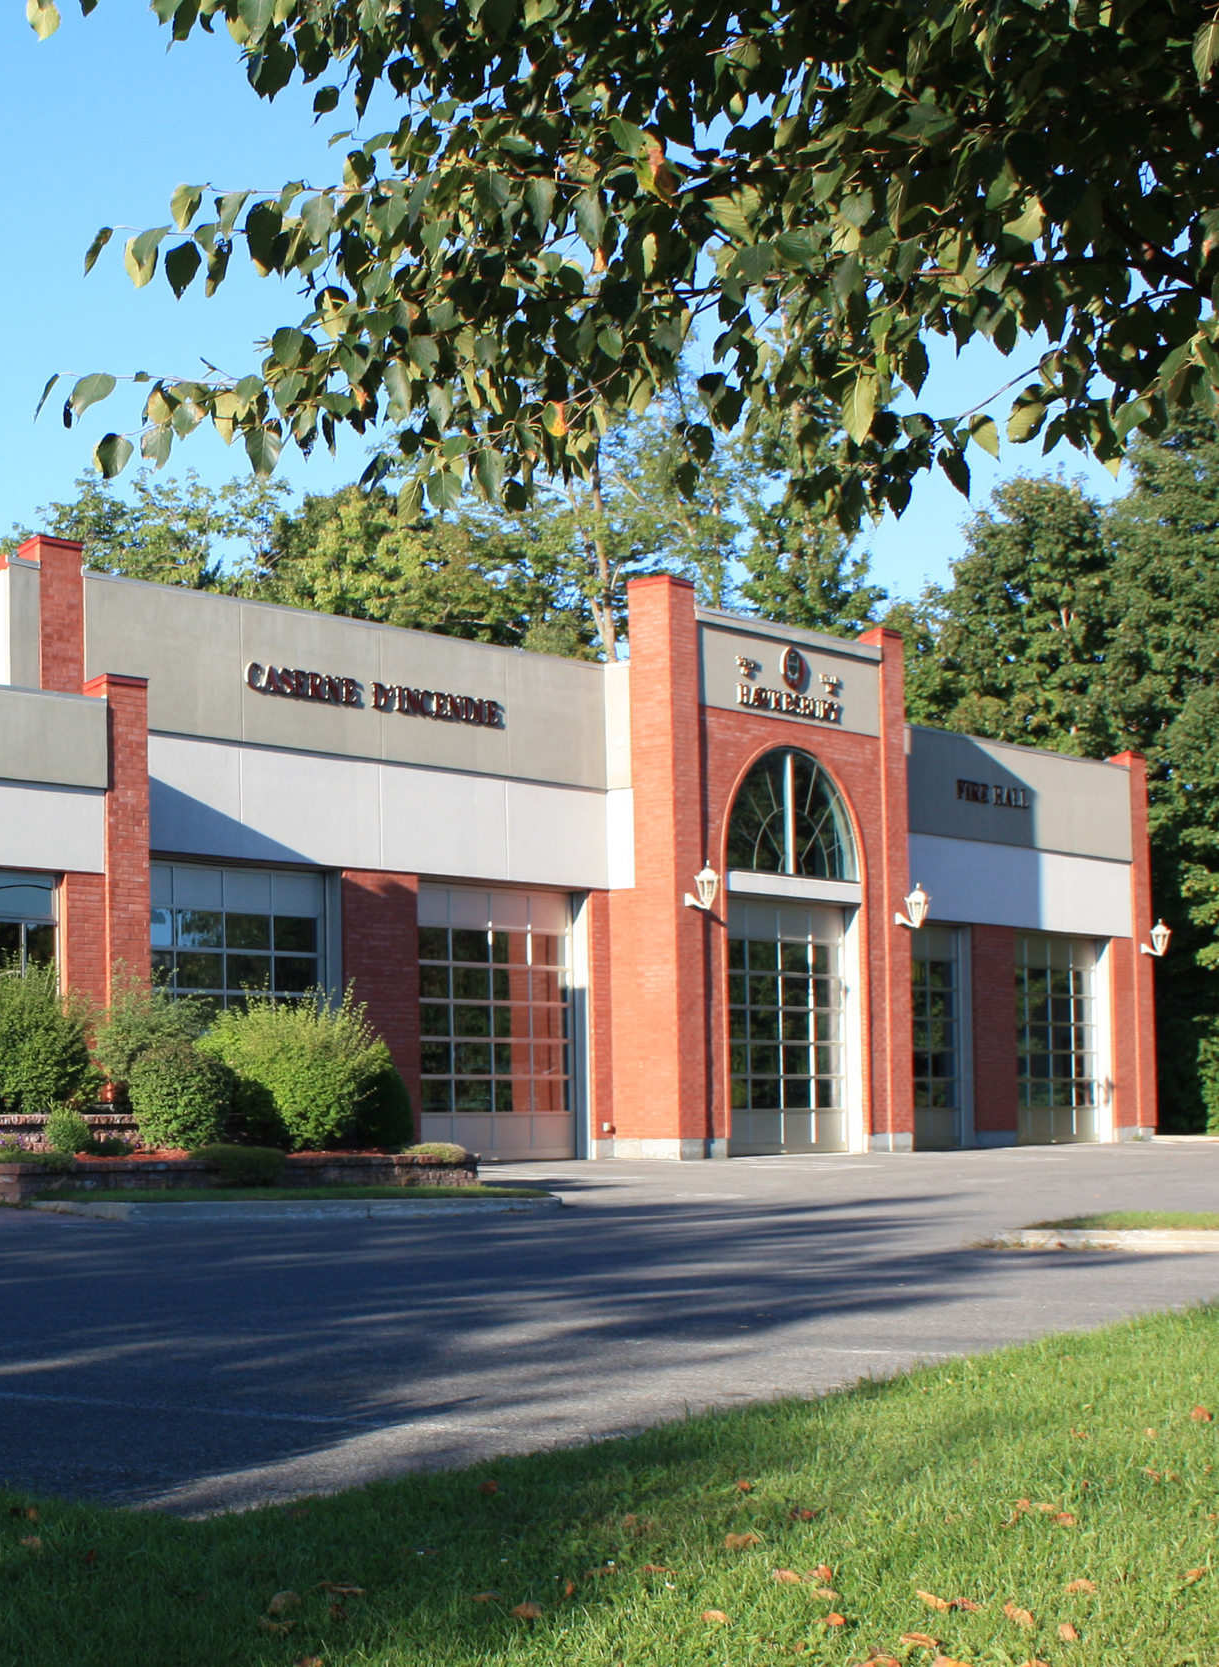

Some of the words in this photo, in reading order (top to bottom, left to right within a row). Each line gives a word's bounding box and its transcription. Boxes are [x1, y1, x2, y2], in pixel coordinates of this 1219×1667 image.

[244, 661, 358, 705] CASERNE
[370, 681, 500, 726] D'INCENDIE
[956, 779, 989, 804] FIRE
[992, 785, 1029, 809] HALL
